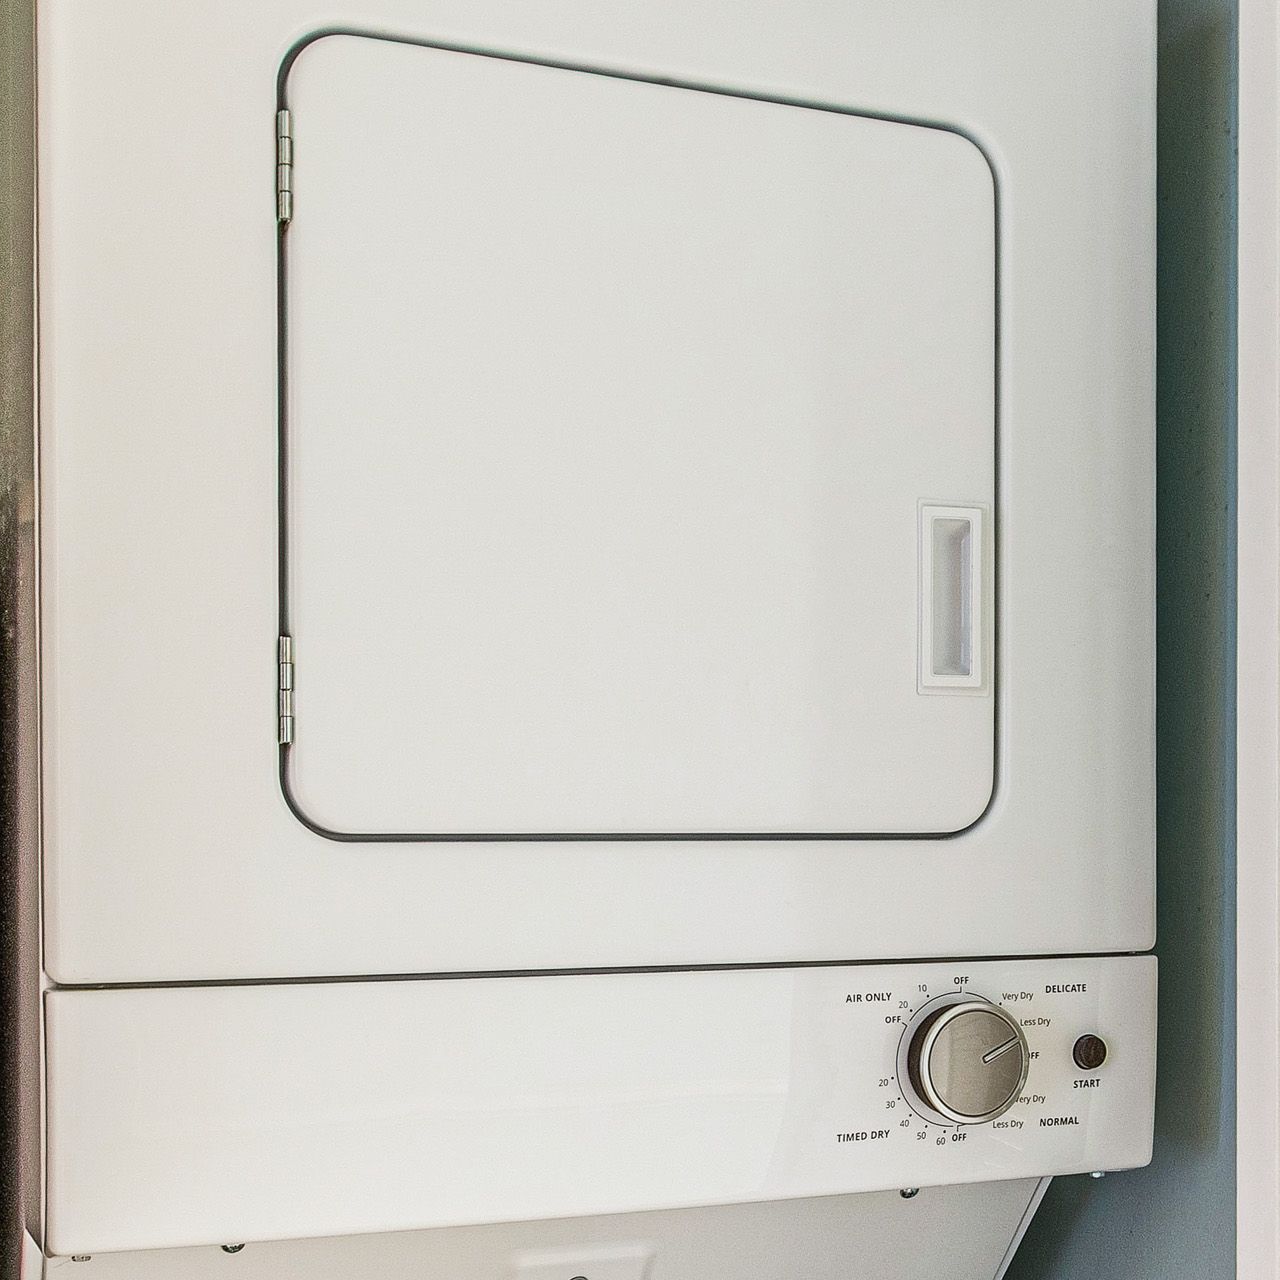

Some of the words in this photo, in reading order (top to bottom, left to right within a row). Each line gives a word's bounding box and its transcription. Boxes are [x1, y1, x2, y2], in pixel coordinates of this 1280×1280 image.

[954, 976, 969, 985] OFF
[918, 984, 927, 992] 10
[1045, 983, 1087, 994] DELICATE
[846, 993, 862, 1003] AIR
[866, 992, 892, 1002] ONLY
[1002, 992, 1017, 1001] Very
[1019, 991, 1033, 1001] Dry
[899, 1000, 908, 1008] 20
[885, 1016, 901, 1024] OFF
[1020, 1017, 1035, 1026] Less
[1036, 1017, 1051, 1027] Dry
[879, 1078, 889, 1087] 20
[1073, 1079, 1101, 1088] START
[1031, 1094, 1046, 1104] Dry
[886, 1100, 895, 1109] 30
[900, 1119, 909, 1127] 40
[993, 1119, 1008, 1128] Less
[1009, 1119, 1024, 1129] Dry
[1039, 1116, 1079, 1127] NORMAL
[837, 1132, 868, 1143] TIMED
[871, 1130, 890, 1140] DRY
[917, 1132, 926, 1140] 50
[952, 1133, 966, 1142] OFF
[936, 1137, 946, 1145] 60
